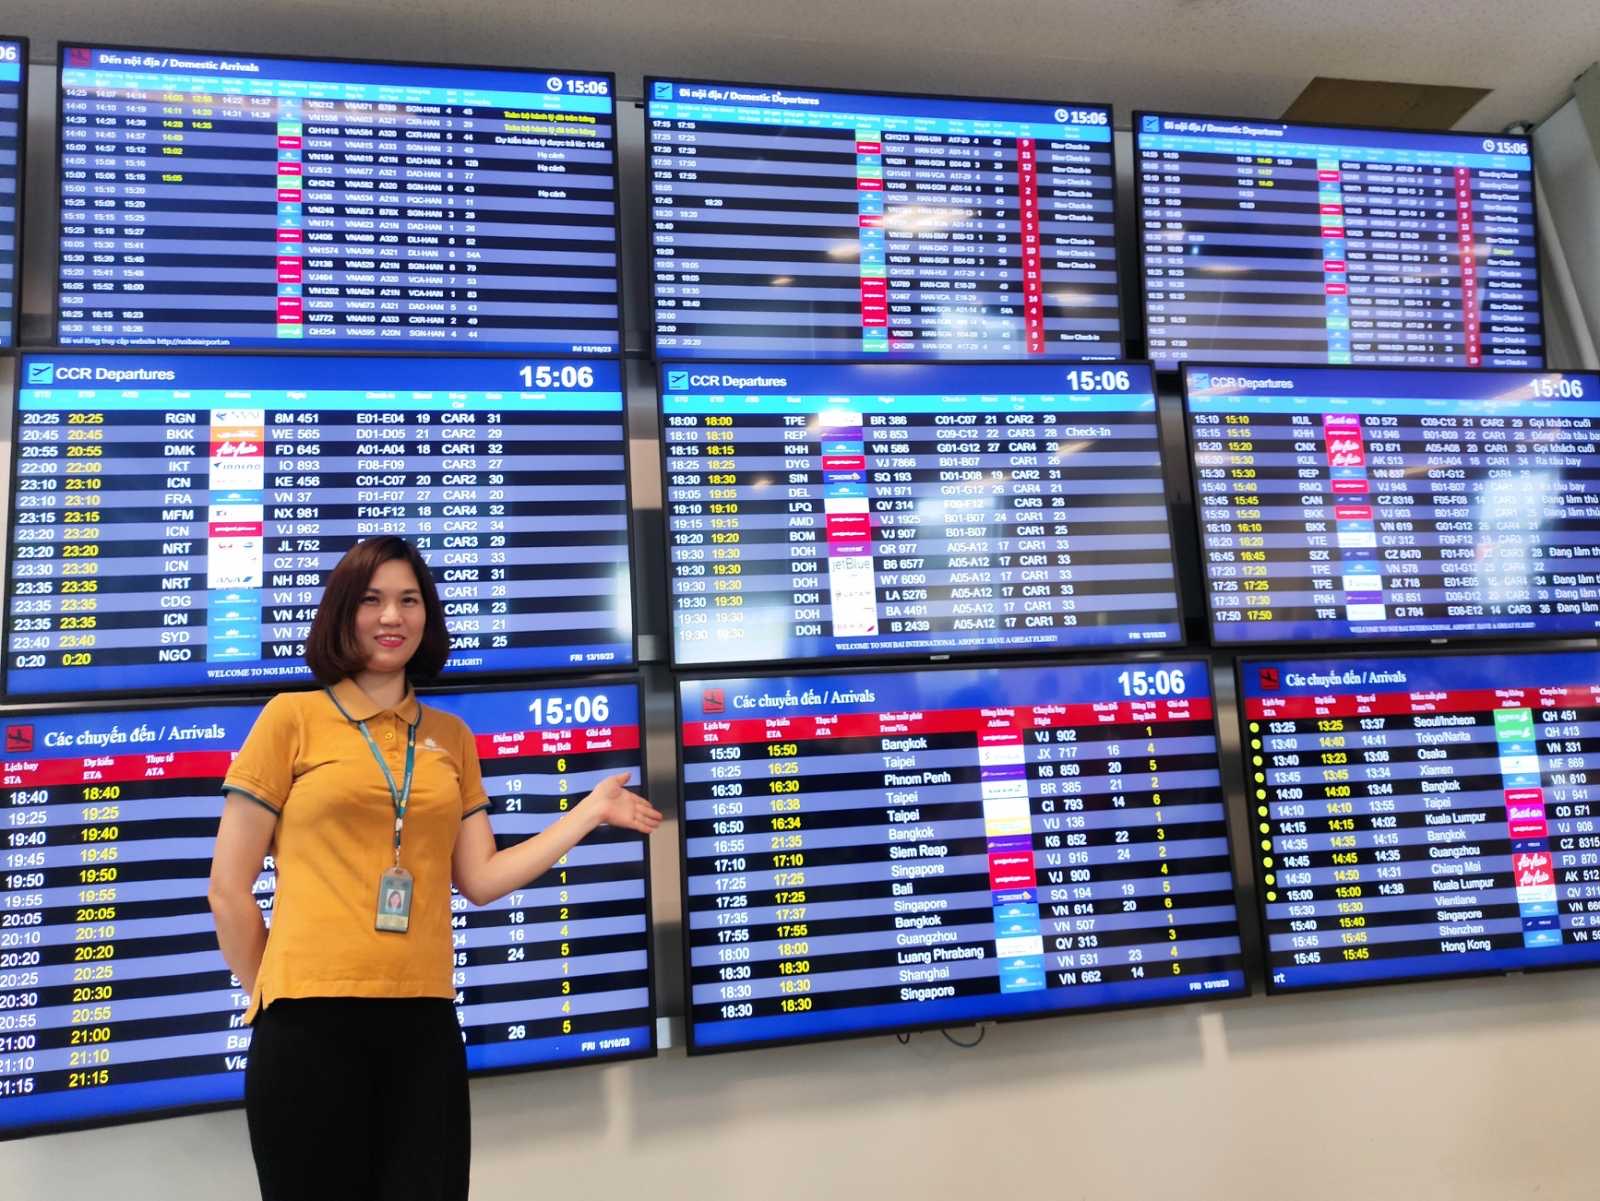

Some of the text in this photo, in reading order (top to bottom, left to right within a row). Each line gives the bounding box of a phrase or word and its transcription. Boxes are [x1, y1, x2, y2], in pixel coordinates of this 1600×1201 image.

[99, 54, 122, 65] Đến
[123, 56, 142, 67] nội
[169, 58, 219, 70] Domestic
[219, 61, 260, 72] Arrivals
[566, 79, 608, 95] 15:06
[729, 91, 771, 102] Domestic
[771, 91, 820, 105] Departures
[1070, 111, 1108, 125] 15:06
[1496, 141, 1528, 155] 15:06
[55, 367, 175, 383] CCR Departures
[519, 365, 594, 388] 15:06
[690, 375, 787, 389] CCR Departures
[1066, 370, 1130, 391] 15:06
[1530, 375, 1583, 399] 15:06
[23, 412, 475, 425] 20:25 20:25 RGN 8M 451 E01-E04 CAR4
[668, 414, 1034, 426] 18:00 TPE C01-C07 CAR2
[1194, 414, 1220, 424] 15:10
[1381, 416, 1398, 426] 572
[166, 428, 406, 440] BKK WE 565 D01-D05
[1065, 426, 1111, 437] Check-In
[22, 443, 475, 457] 20:55 20:55 DMK FD 645 CAR1
[670, 442, 1037, 456] 18:15 18:15 KHH CAR4
[20, 474, 477, 491] 23:10 23:10 ICN KE 456 C01-C07 CAR2
[788, 471, 913, 484] SIN 193
[164, 491, 313, 505] FRA VN 37
[162, 507, 319, 521] MFM NX 981
[673, 500, 914, 514] 19:10 LPQ 314
[789, 528, 917, 542] BOM 907
[17, 539, 320, 559] 23:20 NRT 752
[791, 558, 925, 573] DOH 6577
[272, 573, 320, 586] NH 898
[902, 589, 928, 600] 5276
[158, 648, 192, 662] NGO
[452, 657, 483, 667] FLIGHT!
[207, 666, 294, 678] WELCOME BAI
[1285, 669, 1407, 688] Các chuyến đến Arrivals
[1118, 669, 1185, 697] 15:06
[732, 688, 876, 710] Các chuyến đến Arrivals
[528, 694, 609, 726] 15:06
[1269, 710, 1577, 733] 13:25 13:37 451
[43, 723, 226, 748] Các chuyến đến Arrivals
[709, 729, 1077, 760] 15:50 15:50 Bangkok 902
[1417, 741, 1582, 760] Osaka 331
[882, 755, 916, 770] Taipei
[4, 767, 164, 785] STA ETA ATA
[711, 771, 951, 797] 16:30 Phnom Penh
[1421, 779, 1461, 795] Bangkok
[9, 785, 120, 805] 18:40 18:40
[81, 779, 522, 821] 19:25 19
[7, 798, 522, 847] 19:40 19:40 21
[1452, 812, 1486, 825] Lumpur
[918, 844, 948, 858] Reap
[5, 867, 117, 889] 19:50 19:50
[891, 864, 945, 879] Singapore
[892, 882, 914, 896] Bali
[1434, 895, 1477, 906] Vientiane
[2, 907, 116, 927] 20:05 20:05
[896, 930, 958, 946] Guangzhou
[1440, 939, 1492, 954] Hong Kong
[507, 947, 525, 962] 24
[897, 946, 985, 965] Luang Phrabang
[899, 966, 950, 982] Shanghai
[720, 970, 1102, 1019] 18:30 18:30 Singapore 662
[70, 1027, 111, 1045] 21:00
[68, 1025, 526, 1088] 21:15 26
